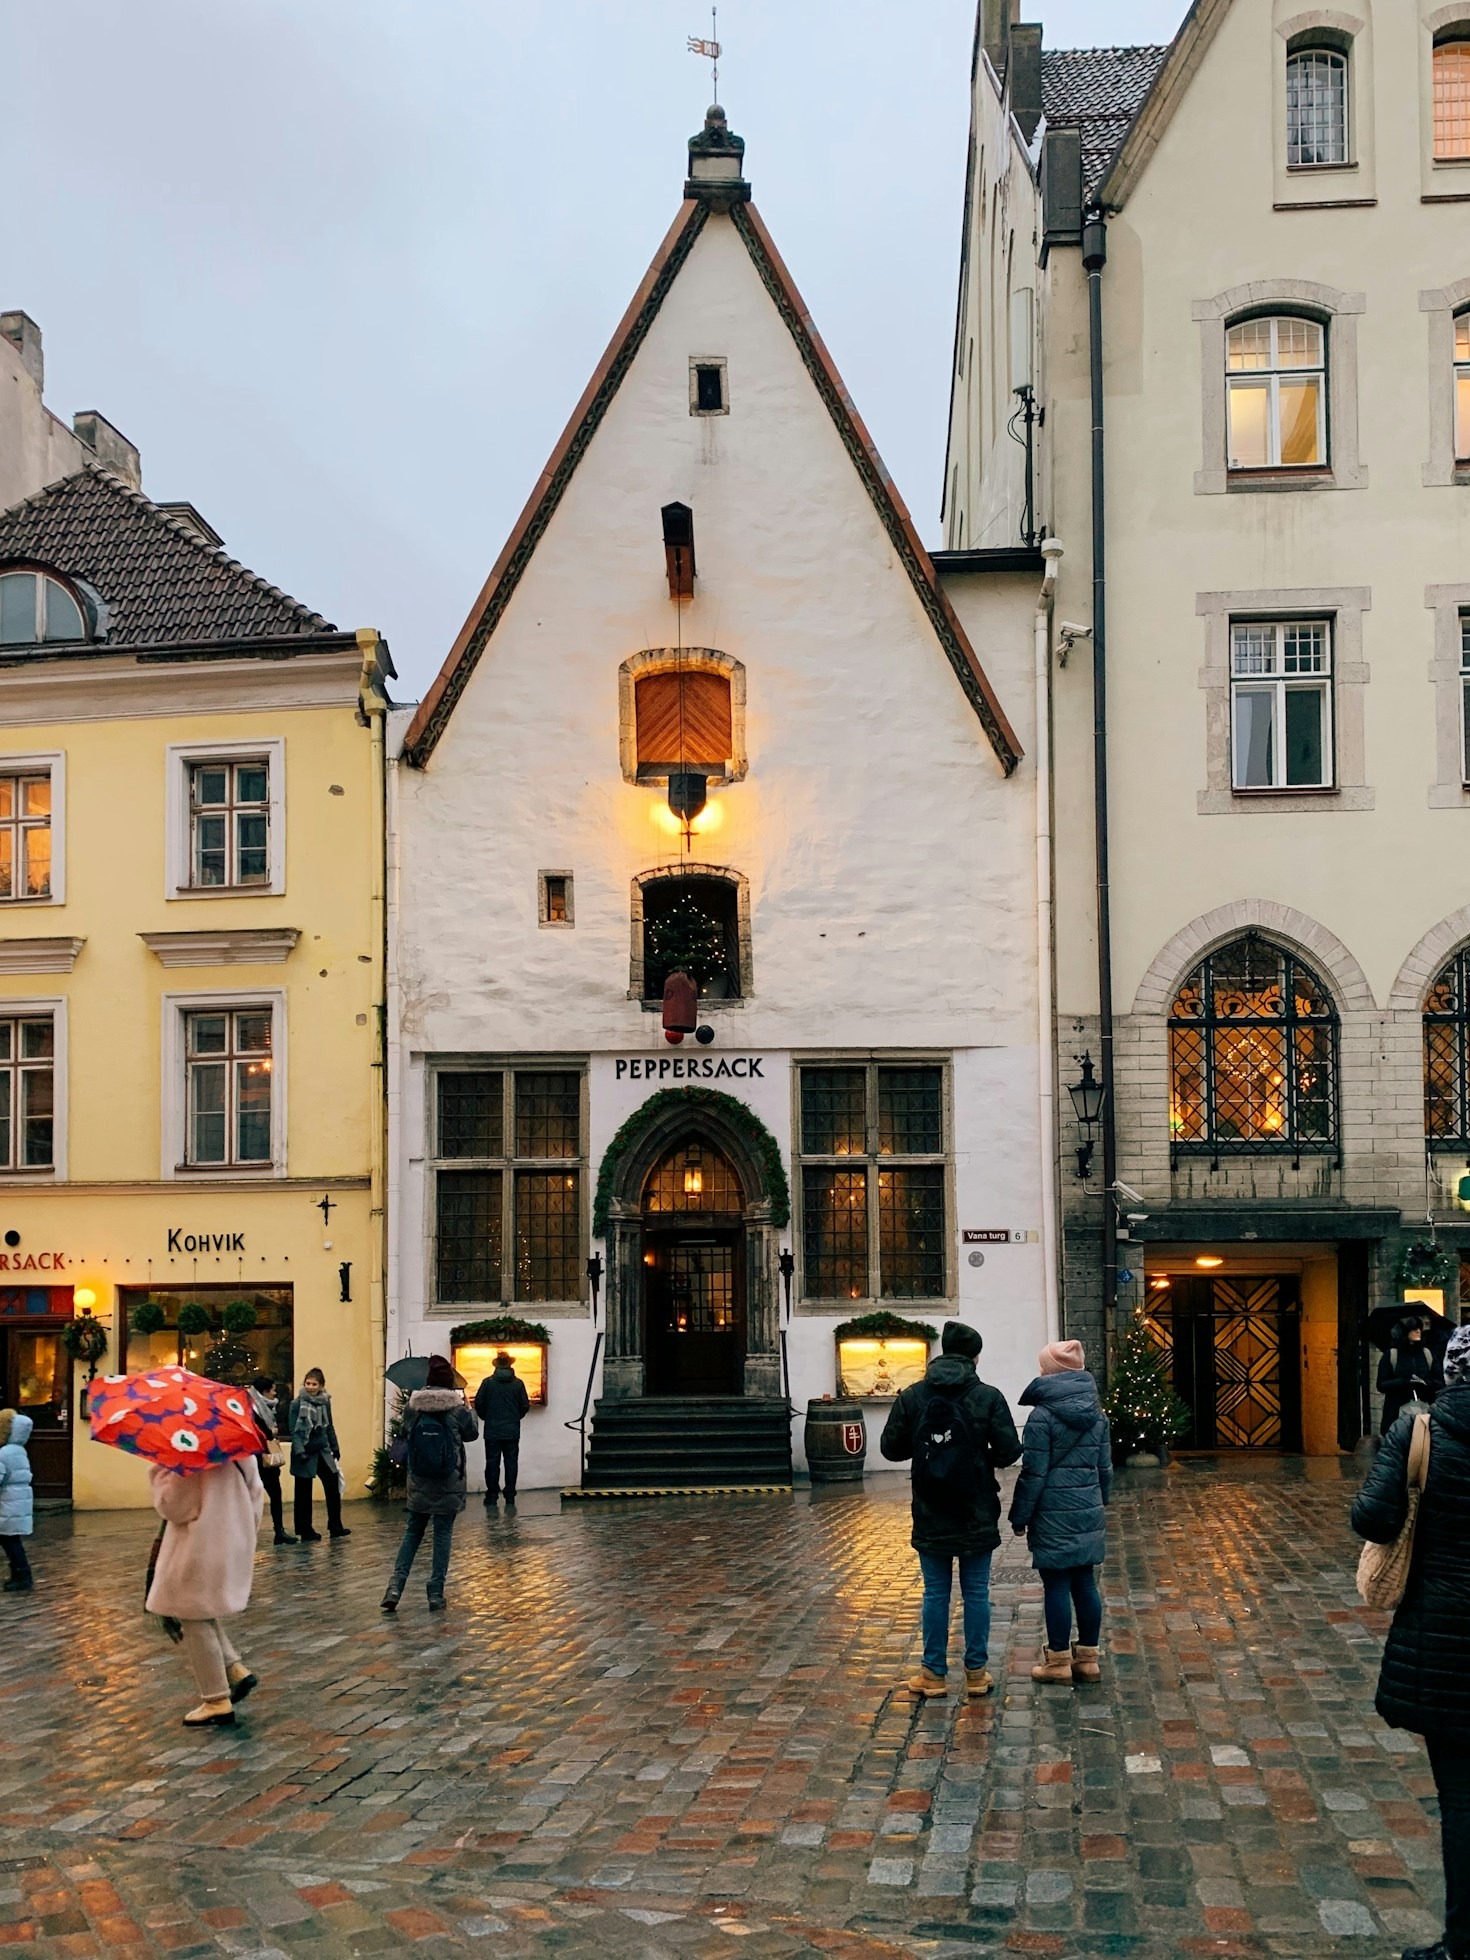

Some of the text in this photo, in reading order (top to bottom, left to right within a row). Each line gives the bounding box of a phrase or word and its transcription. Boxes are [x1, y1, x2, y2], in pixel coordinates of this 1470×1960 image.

[615, 1057, 765, 1080] PEPPERSACK
[168, 1228, 246, 1252] KOHVIK
[967, 1232, 1006, 1241] Vana turg
[1014, 1232, 1021, 1241] 6
[0, 1252, 66, 1271] RSACK
